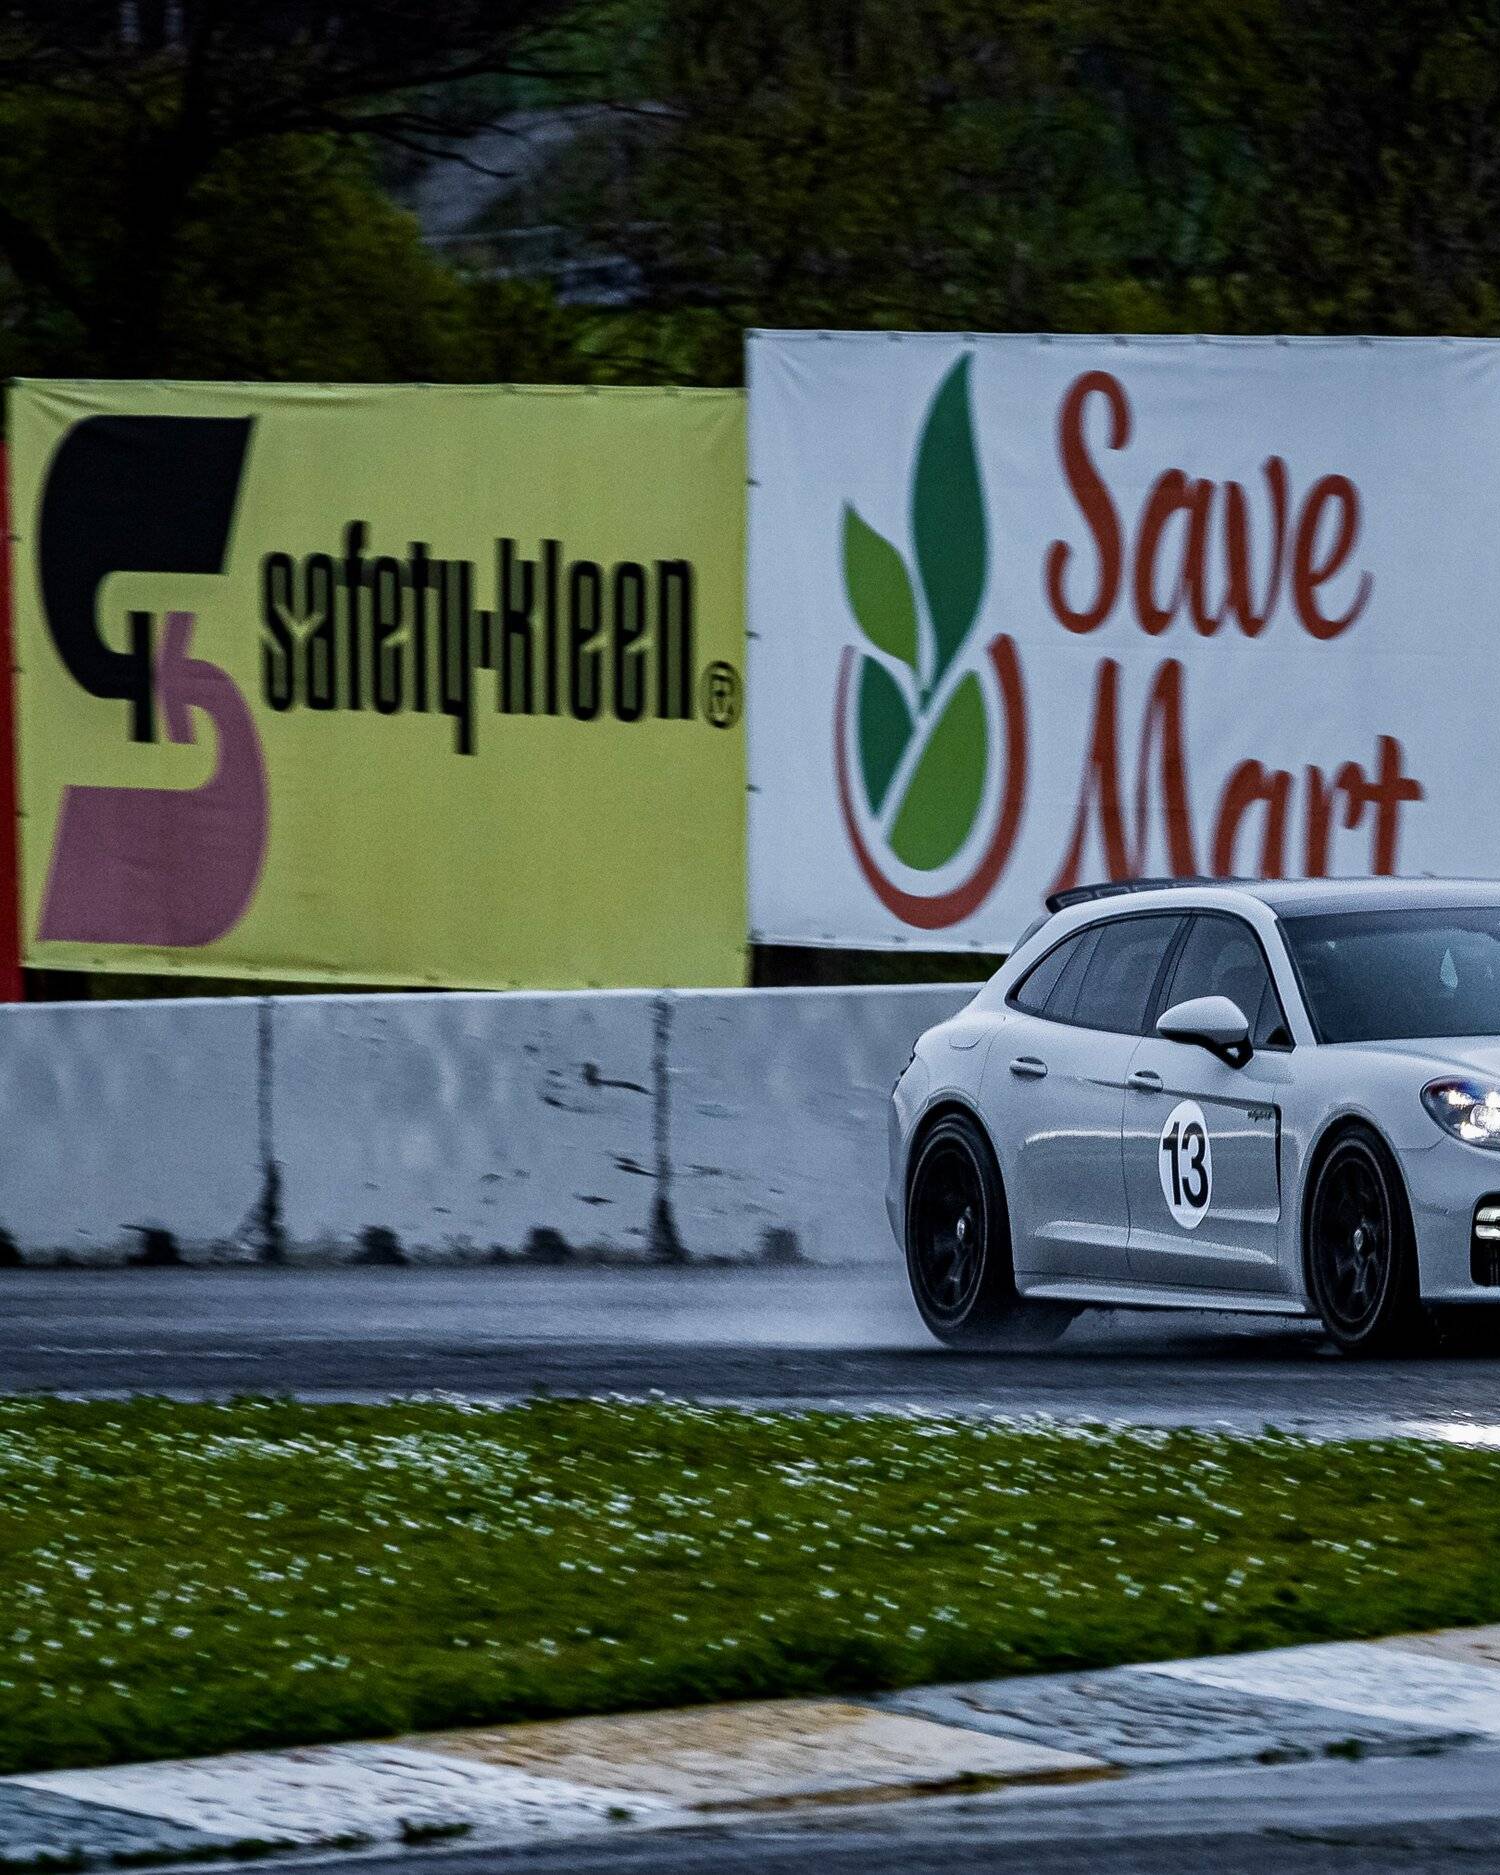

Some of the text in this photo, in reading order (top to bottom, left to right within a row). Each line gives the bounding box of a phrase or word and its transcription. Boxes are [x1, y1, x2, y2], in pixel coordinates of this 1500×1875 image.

[1045, 369, 1375, 640] Save
[1045, 656, 1426, 896] Mart
[1162, 1120, 1210, 1209] 13
